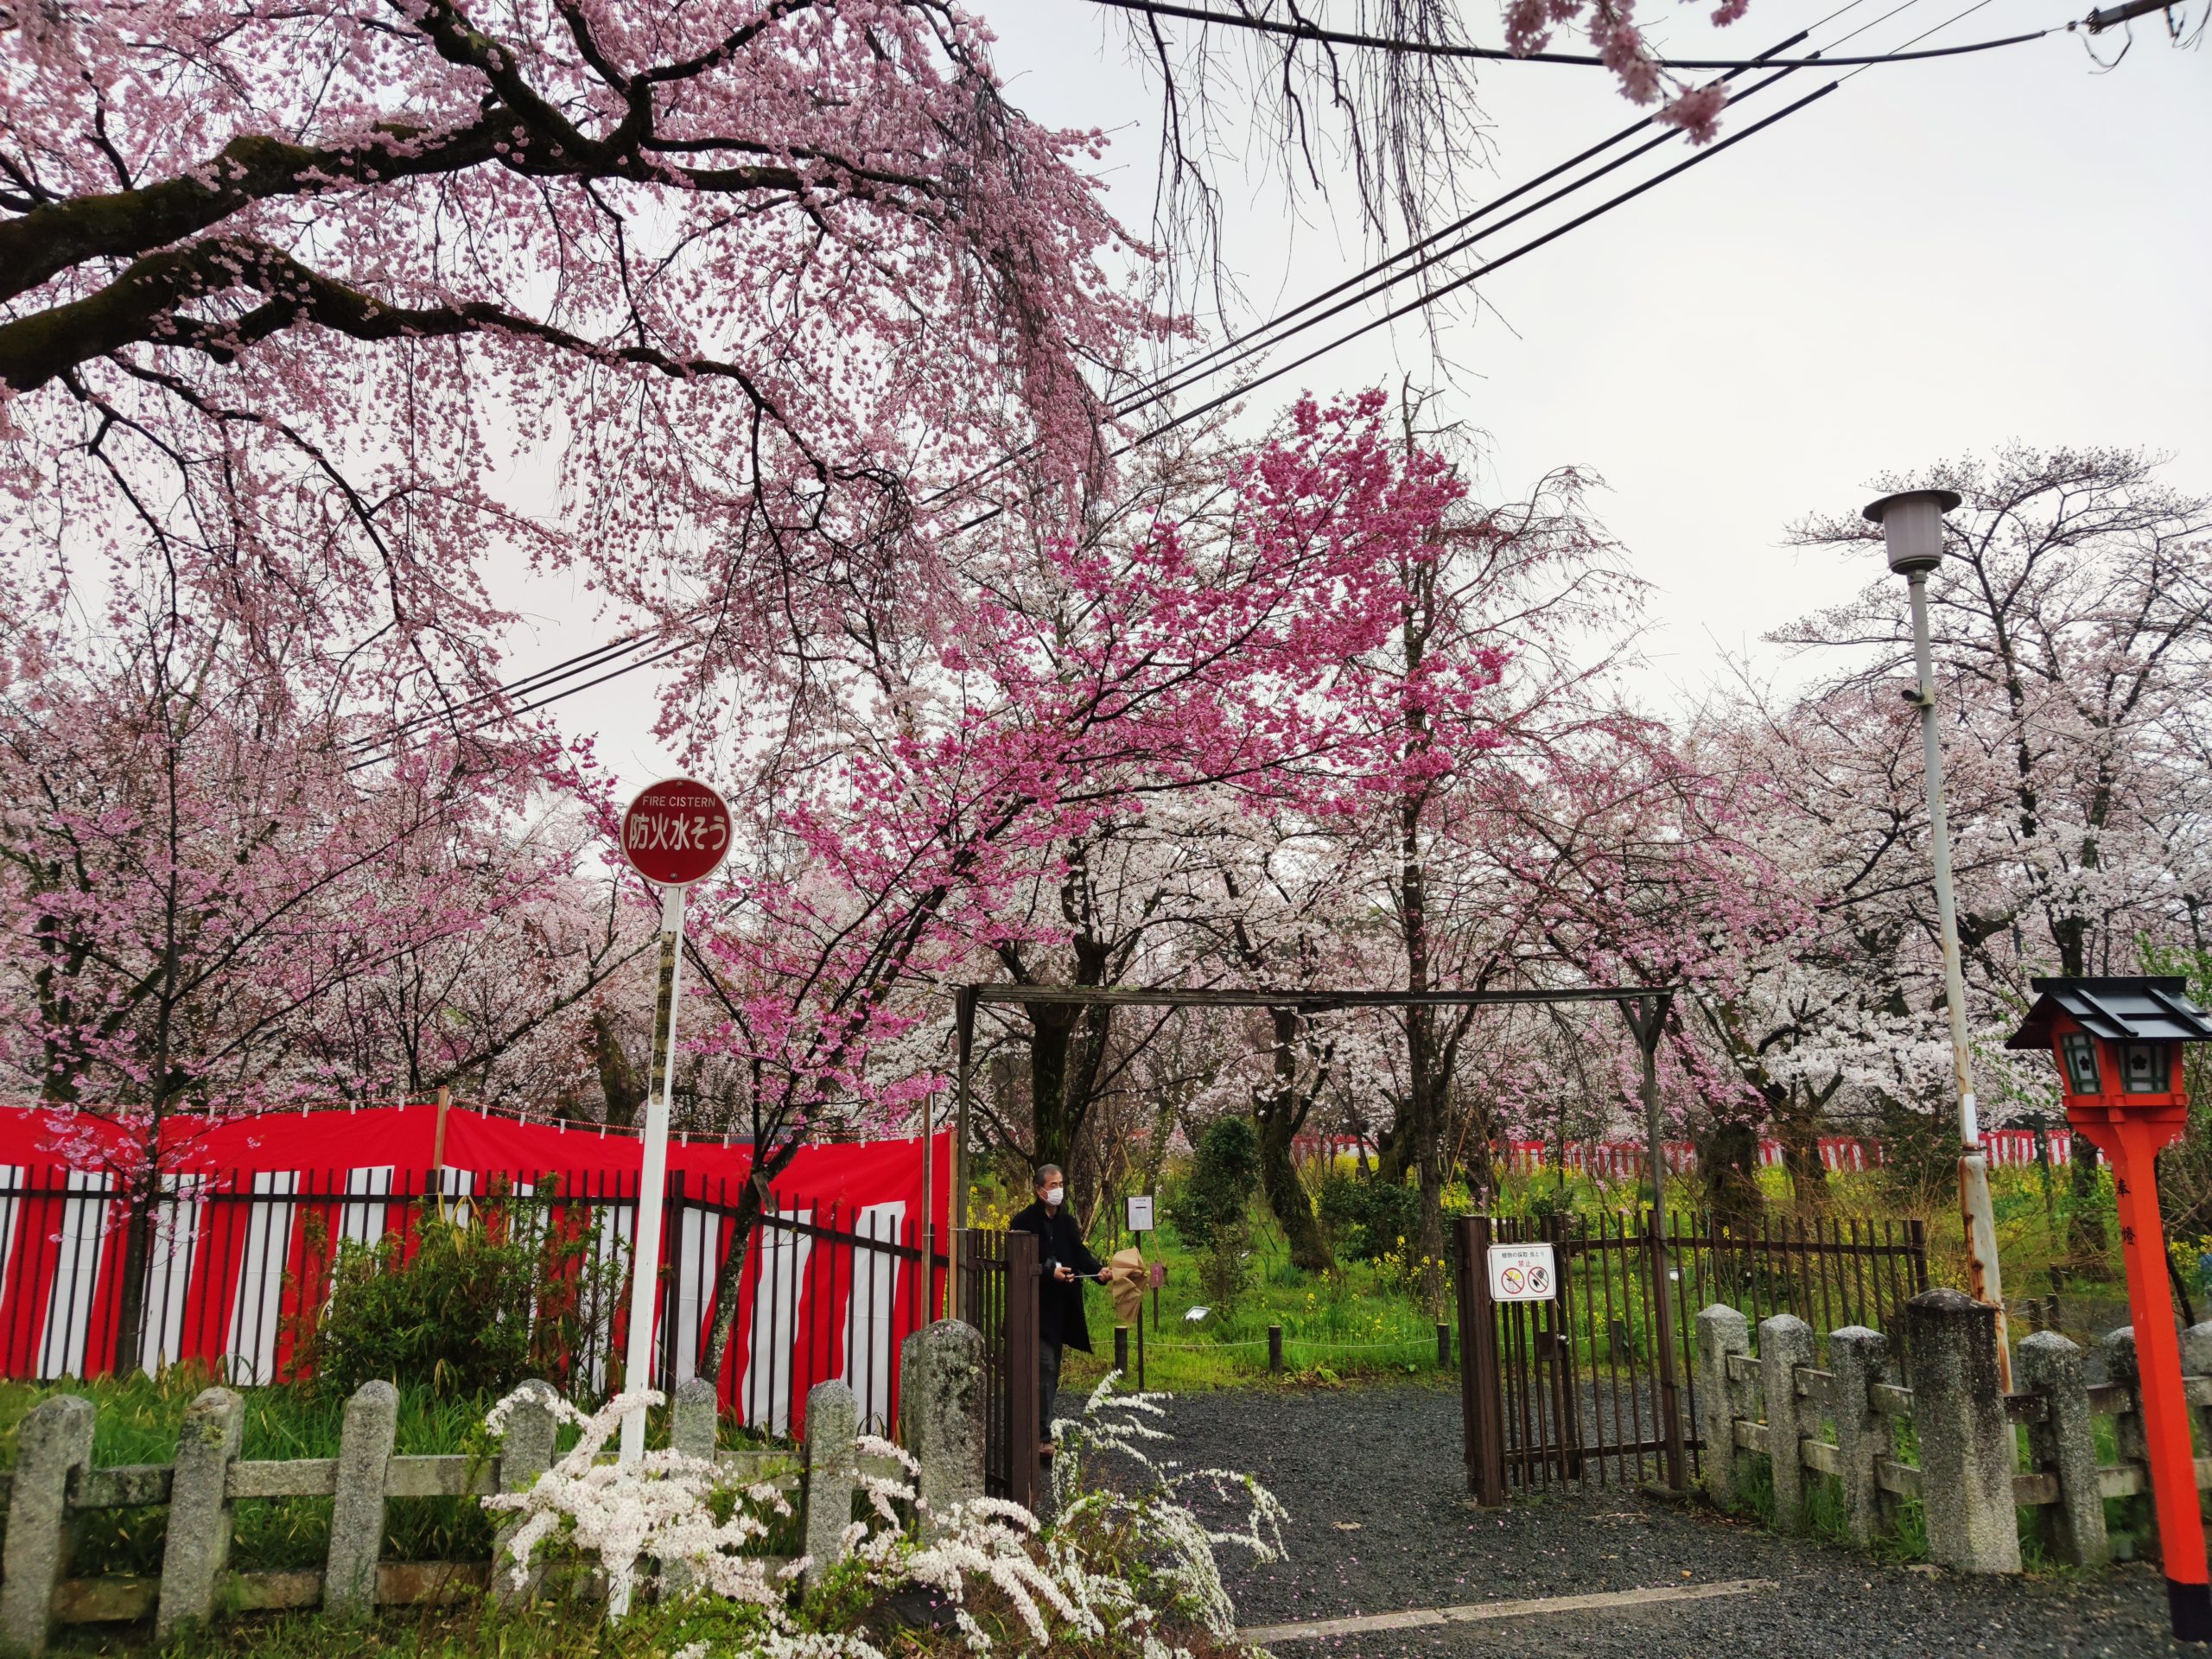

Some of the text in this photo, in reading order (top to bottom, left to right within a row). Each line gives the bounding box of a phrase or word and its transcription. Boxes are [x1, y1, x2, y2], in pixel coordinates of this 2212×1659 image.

[642, 796, 715, 807] FIRE CISTERN
[628, 812, 727, 851] 防火水そう
[650, 940, 676, 1096] 京都市消防局
